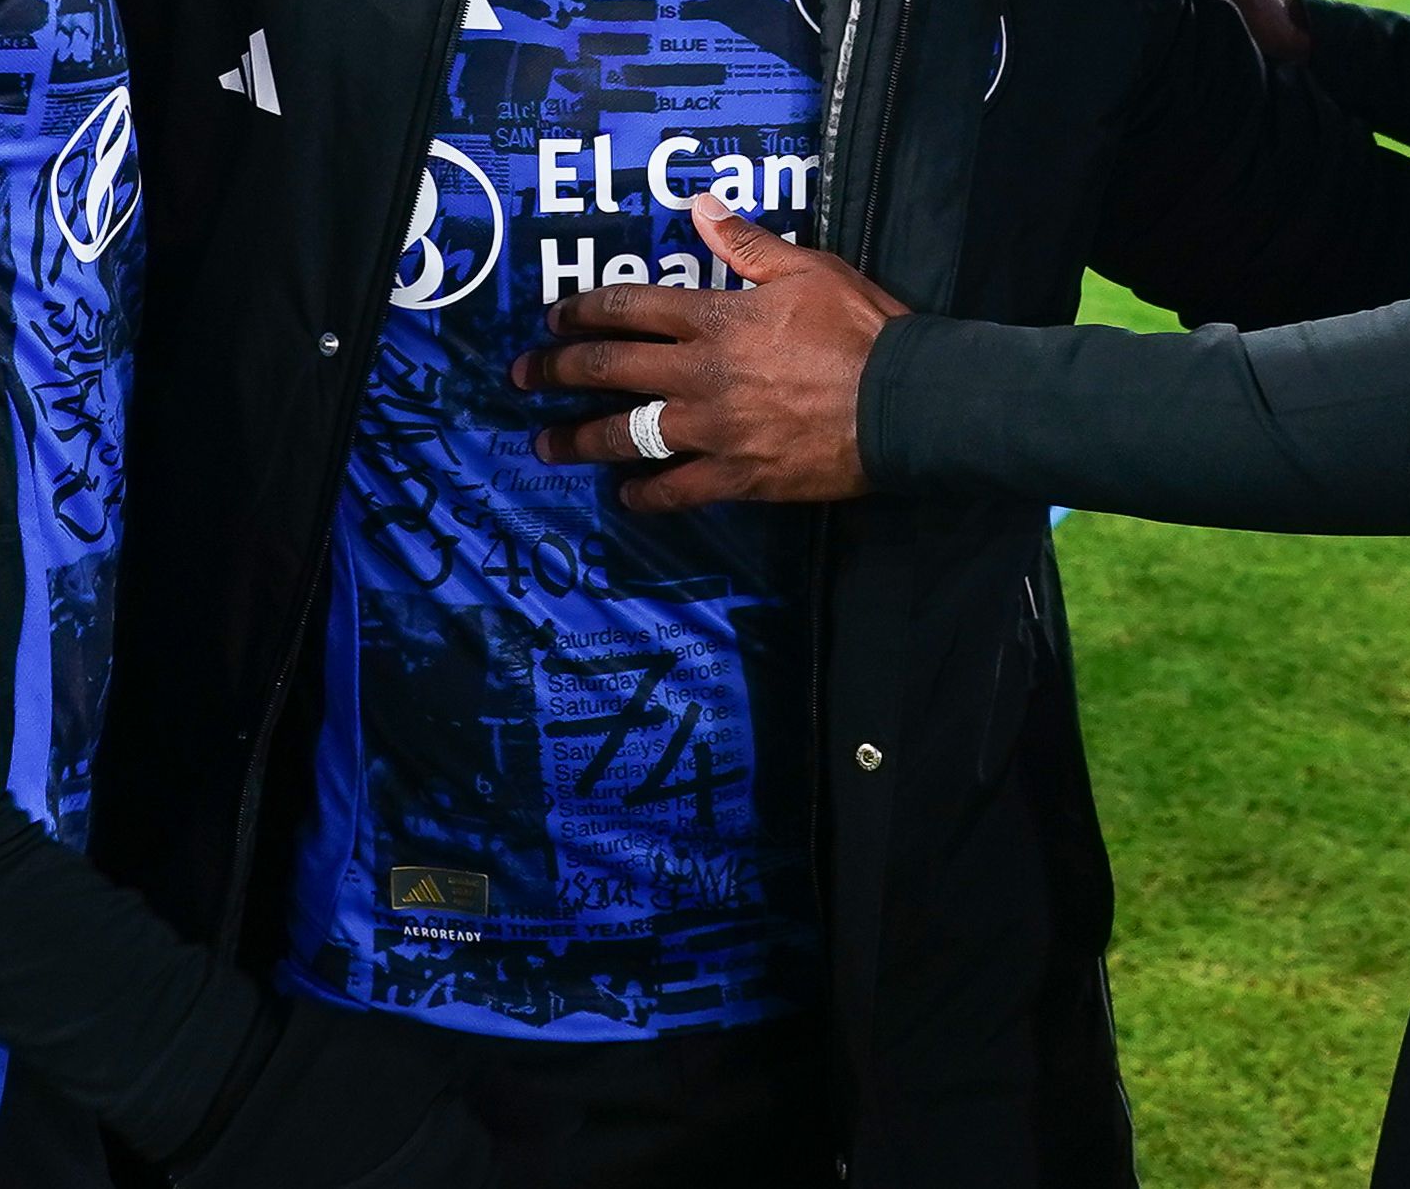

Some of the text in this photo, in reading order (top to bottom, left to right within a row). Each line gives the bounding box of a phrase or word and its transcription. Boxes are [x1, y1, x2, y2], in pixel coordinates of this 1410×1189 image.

[659, 5, 677, 20] IS
[659, 38, 708, 53] BLUE
[658, 96, 723, 112] BLACK
[538, 133, 621, 214] El
[490, 467, 592, 499] Champs
[482, 525, 620, 601] 408
